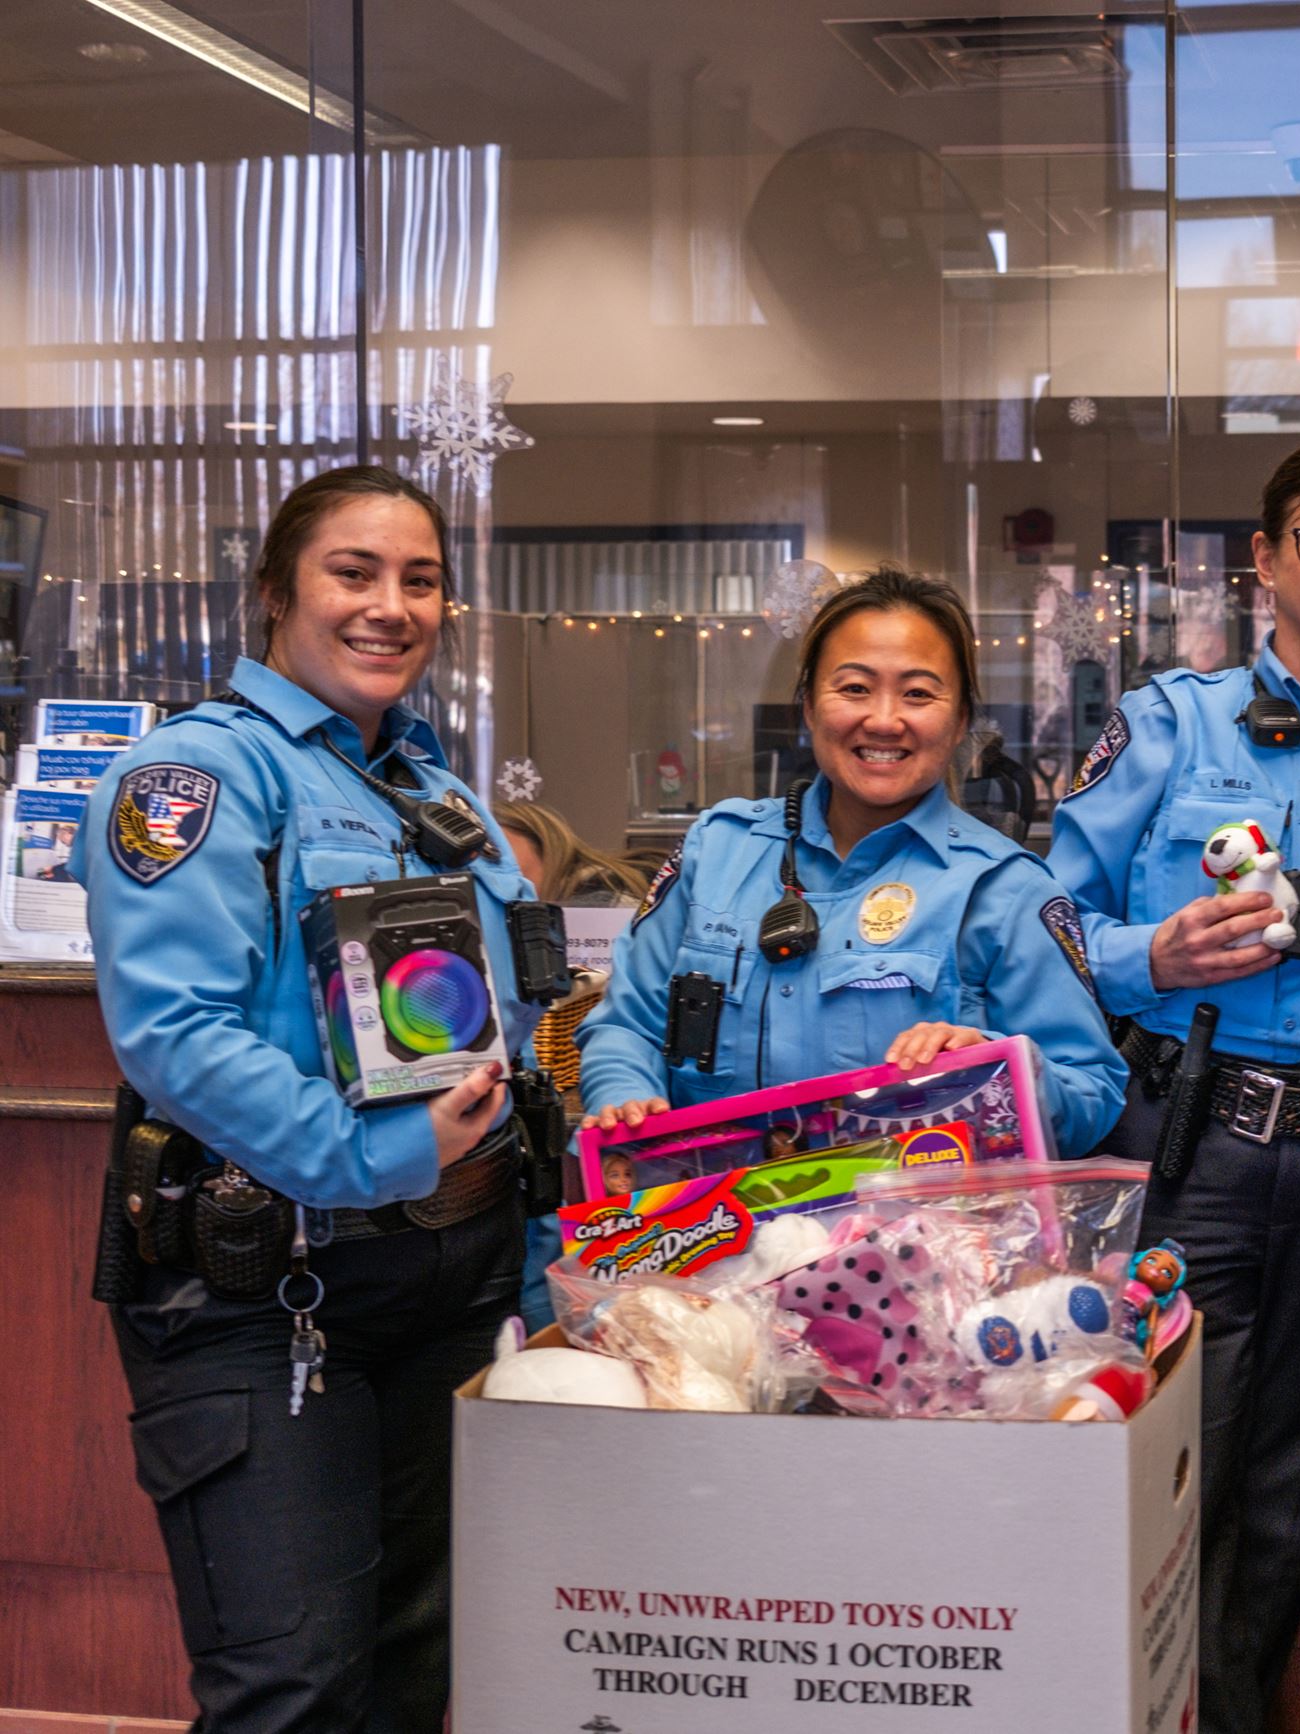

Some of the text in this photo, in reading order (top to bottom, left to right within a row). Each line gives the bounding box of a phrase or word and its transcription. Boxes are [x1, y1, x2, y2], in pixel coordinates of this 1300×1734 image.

[126, 777, 210, 803] POLICE
[170, 769, 210, 786] VALLEY
[1223, 778, 1252, 790] MILLS
[905, 1148, 961, 1167] DELUXE
[554, 1587, 1019, 1631] NEW, UNWRAPPED TOYS ONLY
[563, 1628, 1004, 1671] CAMPAIGN RUNS 1 OCTOBER
[593, 1667, 974, 1707] THROUGH DECEMBER
